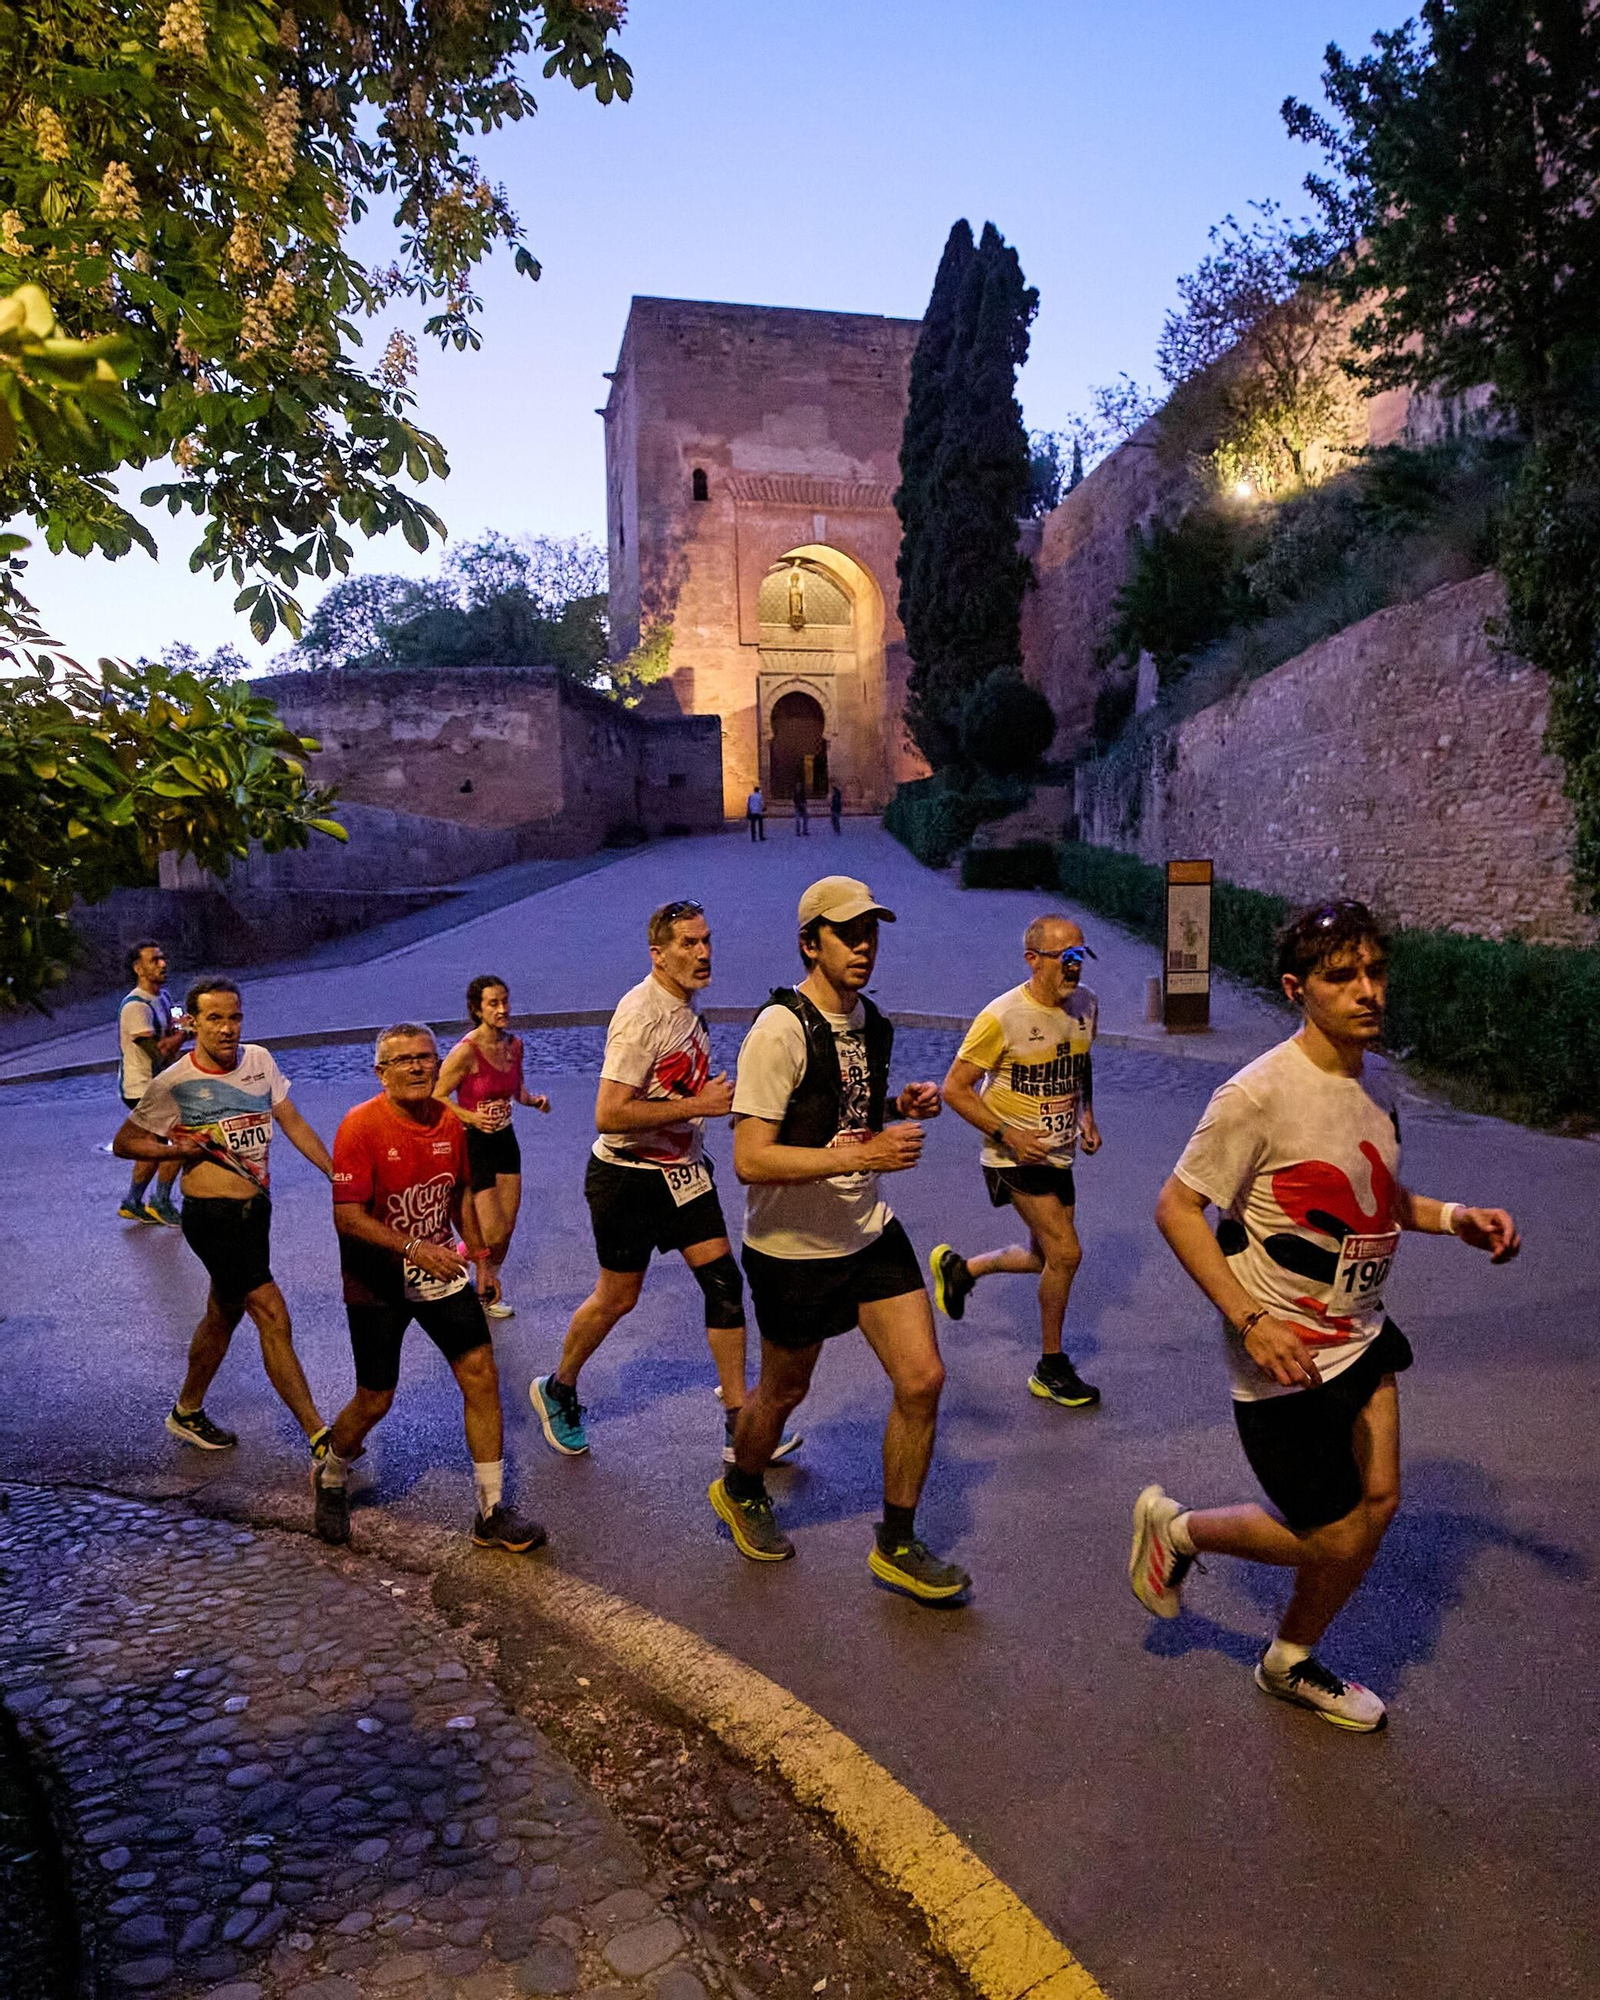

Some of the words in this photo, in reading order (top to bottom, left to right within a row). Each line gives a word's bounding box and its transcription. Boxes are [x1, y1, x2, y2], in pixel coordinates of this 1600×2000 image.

[1041, 1112, 1074, 1133] 332
[228, 1127, 266, 1151] 5470
[668, 1161, 701, 1191] 397
[1345, 1240, 1363, 1258] 41
[1341, 1258, 1390, 1293] 190
